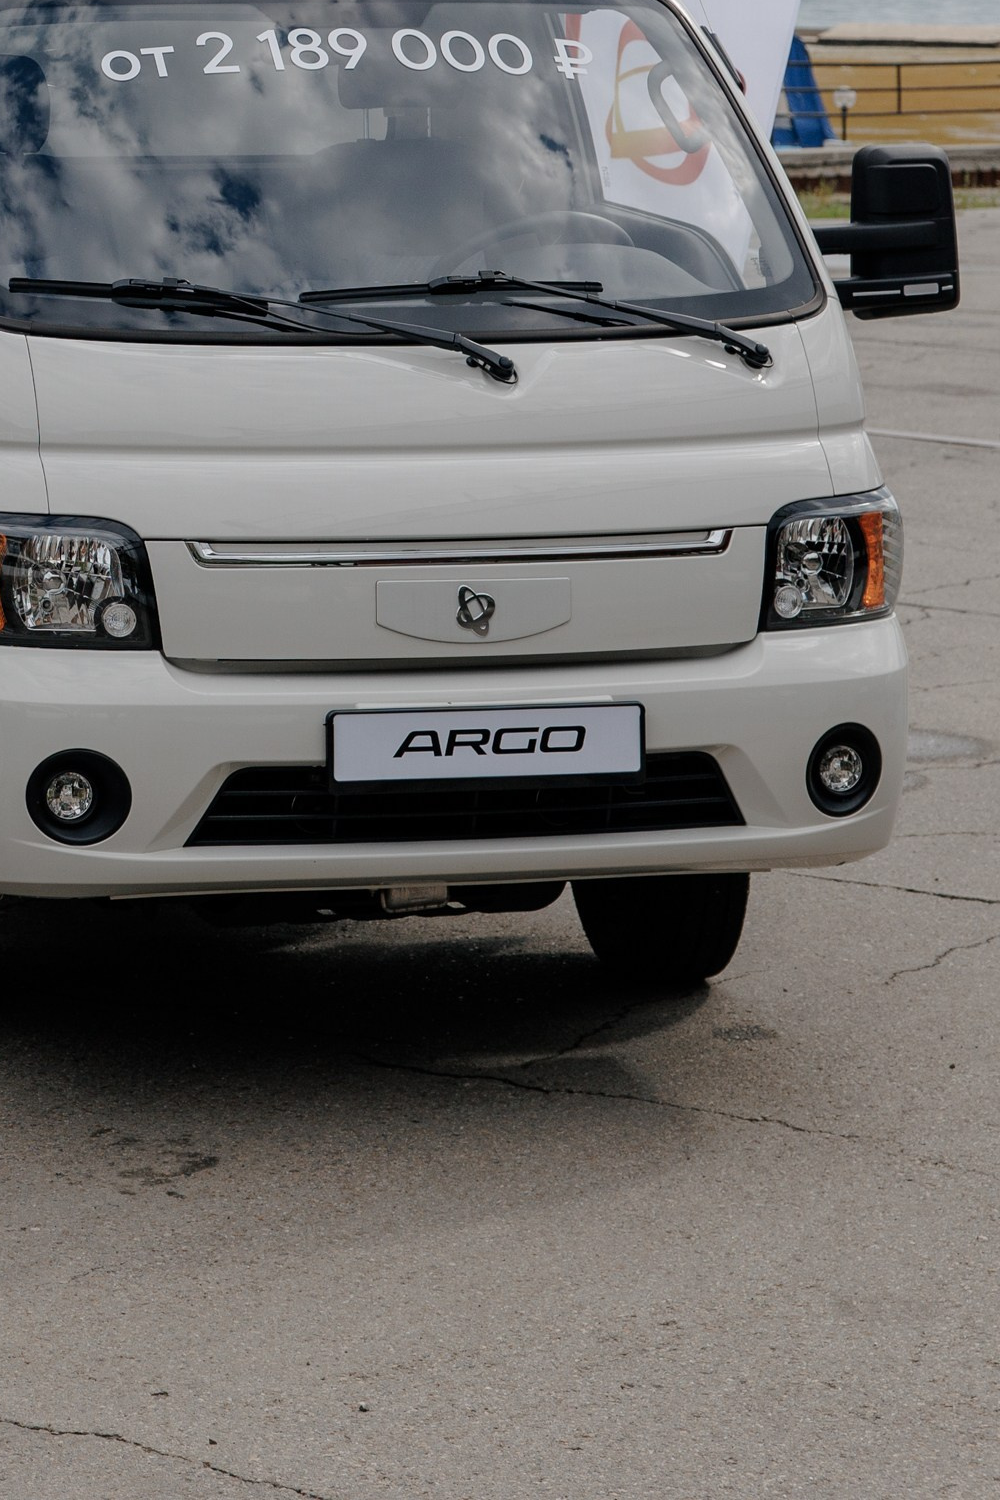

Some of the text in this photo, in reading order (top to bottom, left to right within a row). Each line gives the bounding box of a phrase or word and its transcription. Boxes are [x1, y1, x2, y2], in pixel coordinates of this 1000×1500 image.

[195, 31, 241, 75] 2
[256, 27, 368, 71] 189
[391, 28, 533, 76] 000
[392, 724, 587, 758] ARGO
